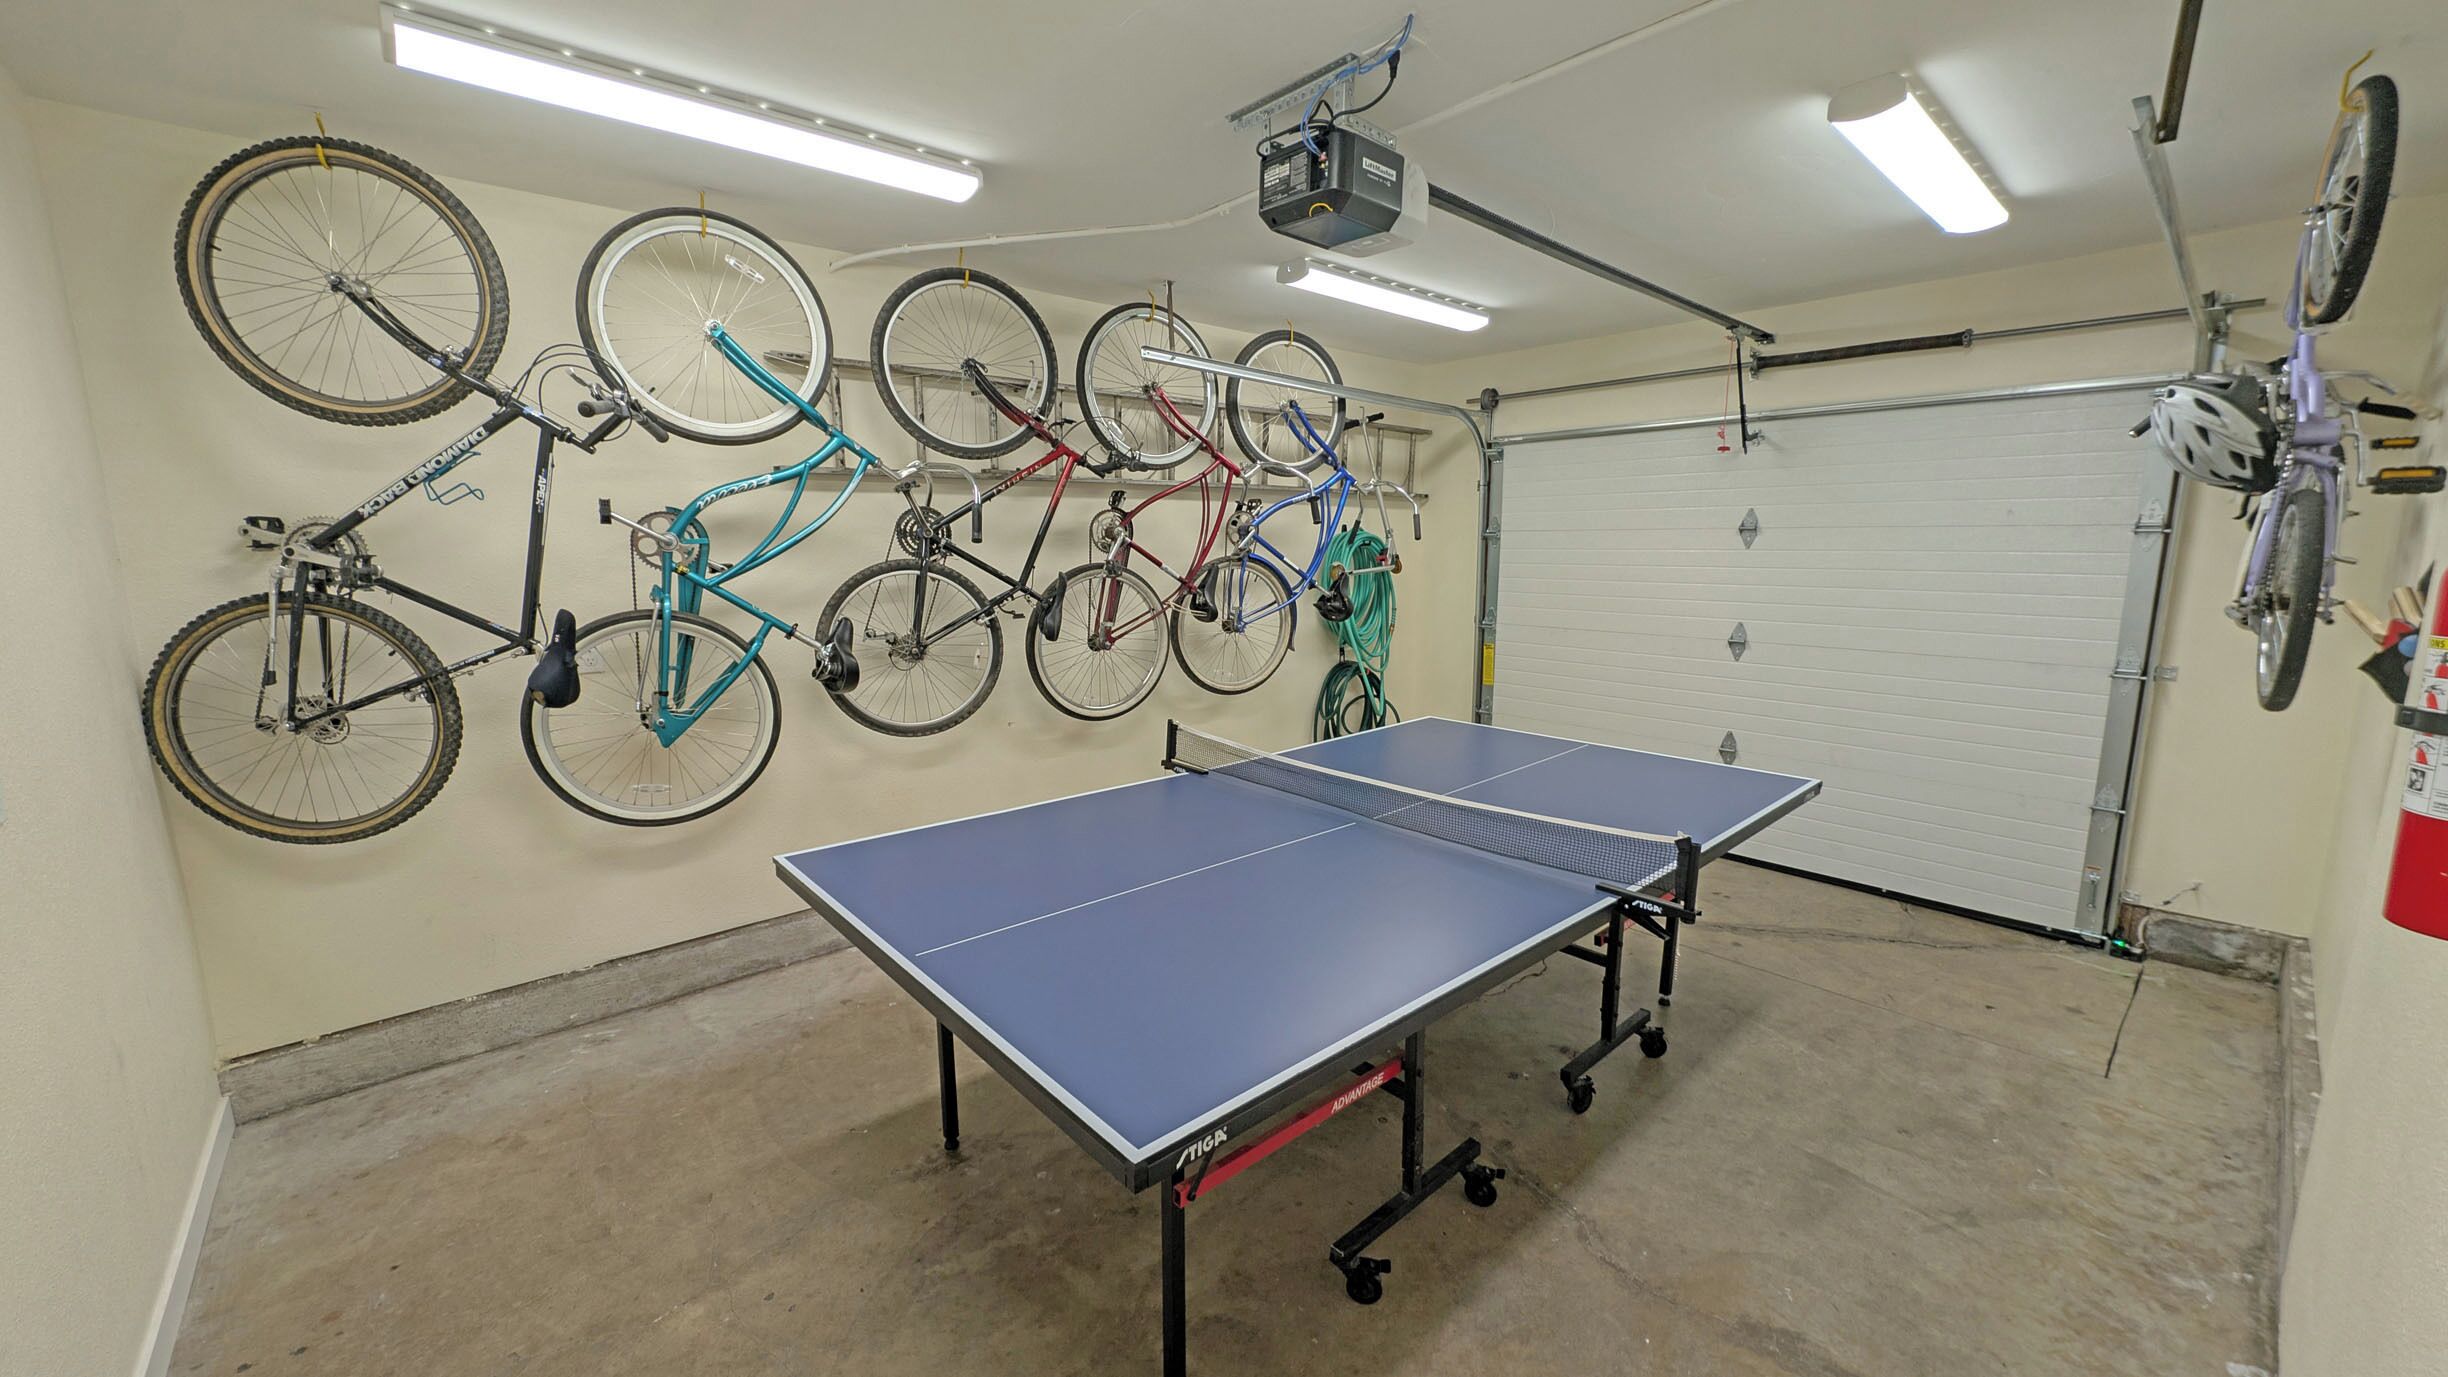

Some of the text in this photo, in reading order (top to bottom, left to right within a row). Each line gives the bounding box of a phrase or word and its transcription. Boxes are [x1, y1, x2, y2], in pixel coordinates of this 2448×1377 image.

[358, 426, 490, 518] DIAMOND BACK
[536, 474, 547, 505] APEX
[1632, 900, 1662, 914] STIGA
[1331, 1072, 1385, 1114] ADVANTAGE
[1176, 1128, 1228, 1170] STIGA
